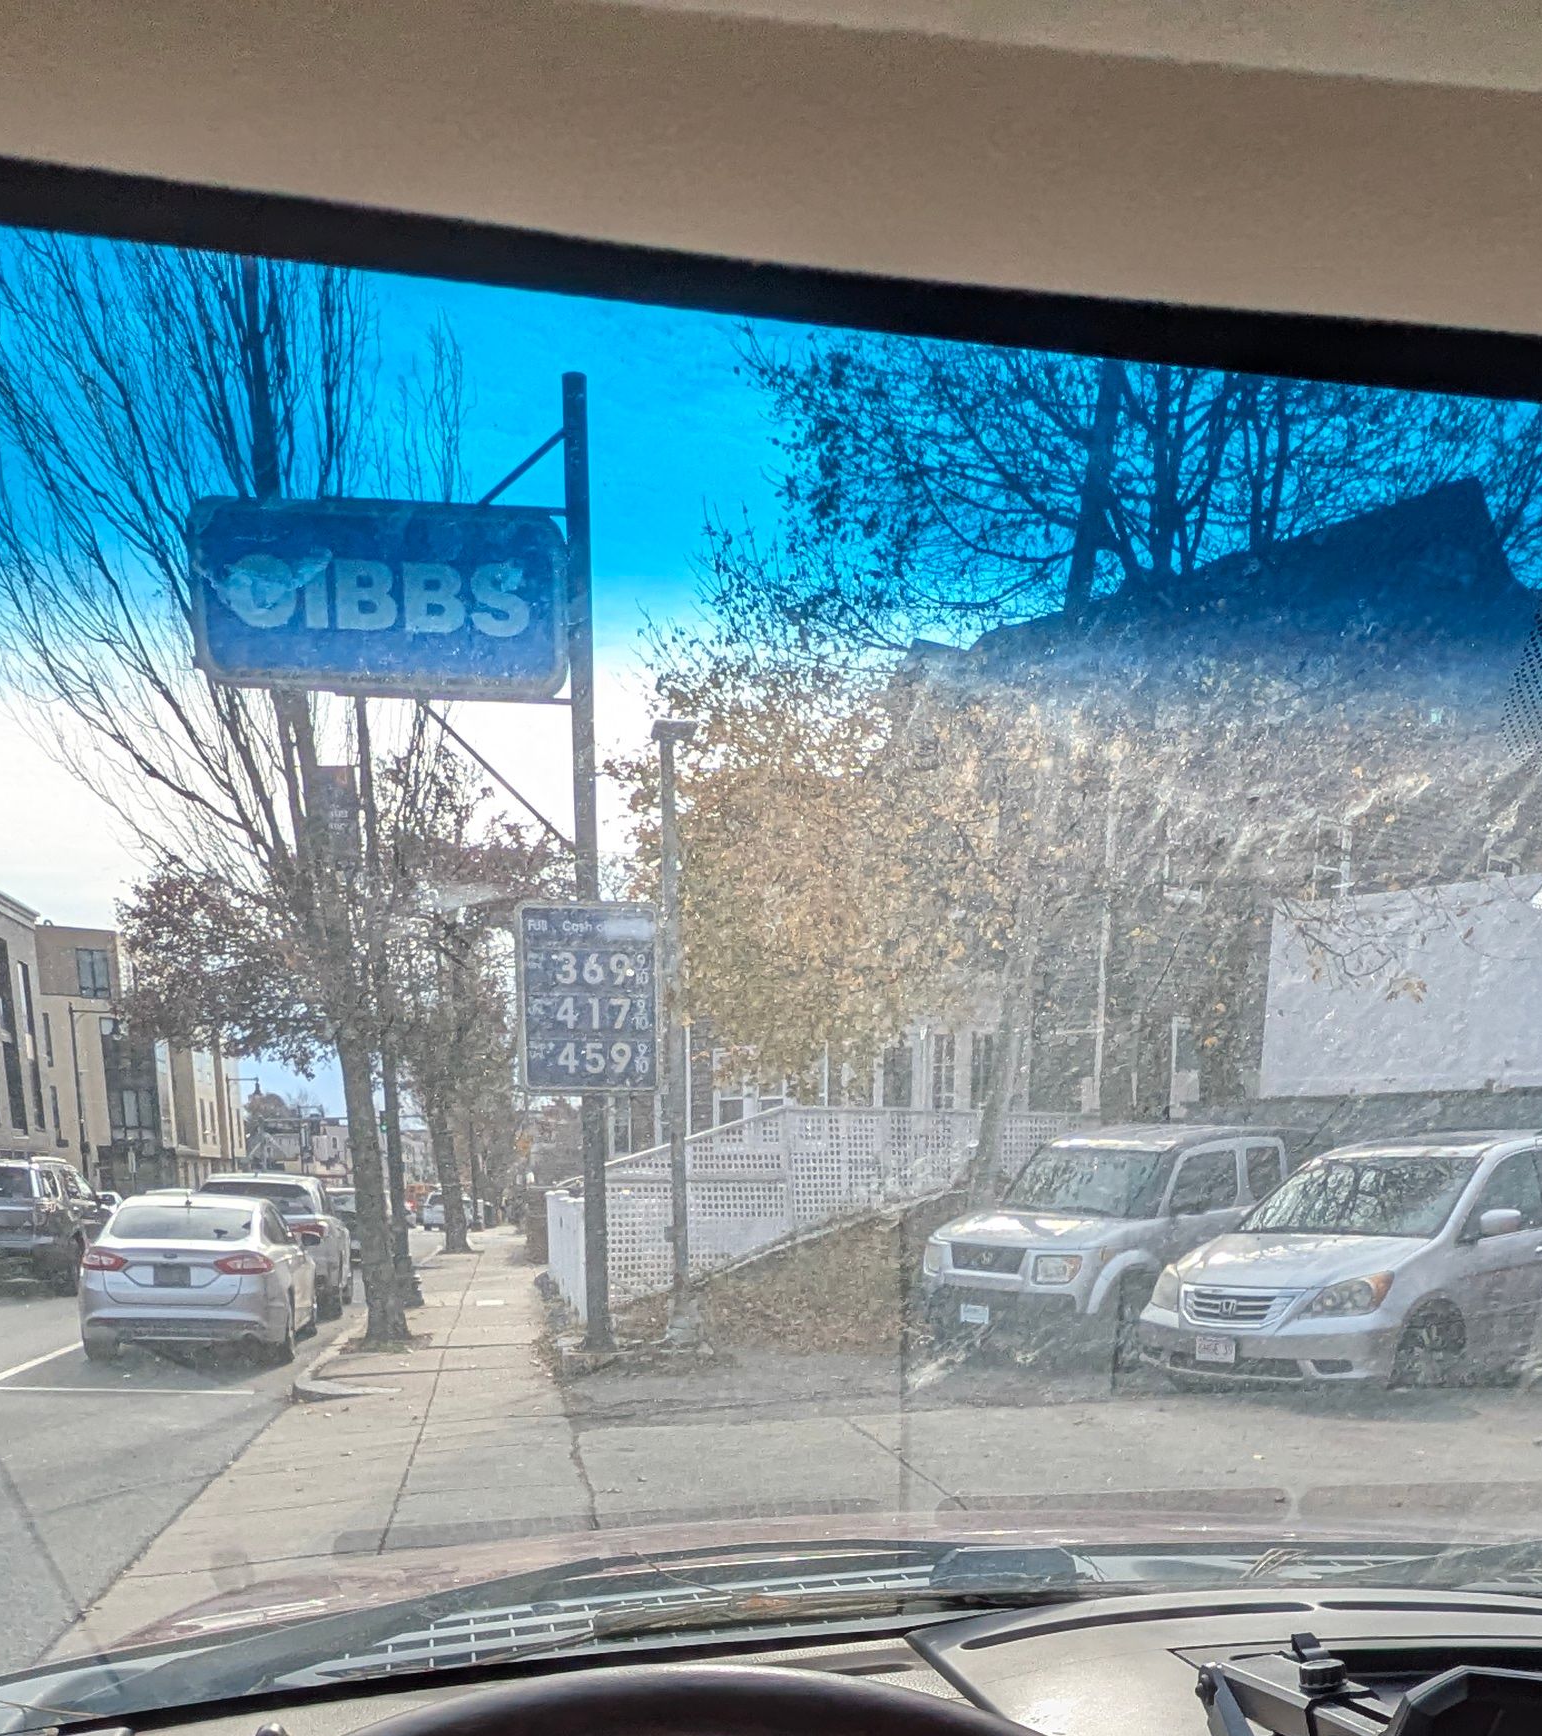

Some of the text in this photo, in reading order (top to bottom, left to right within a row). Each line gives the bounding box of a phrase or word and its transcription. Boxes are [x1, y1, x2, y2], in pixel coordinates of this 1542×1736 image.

[562, 920, 593, 932] Cash
[556, 951, 631, 985] 369
[556, 997, 631, 1030] 417
[557, 1042, 633, 1075] 459
